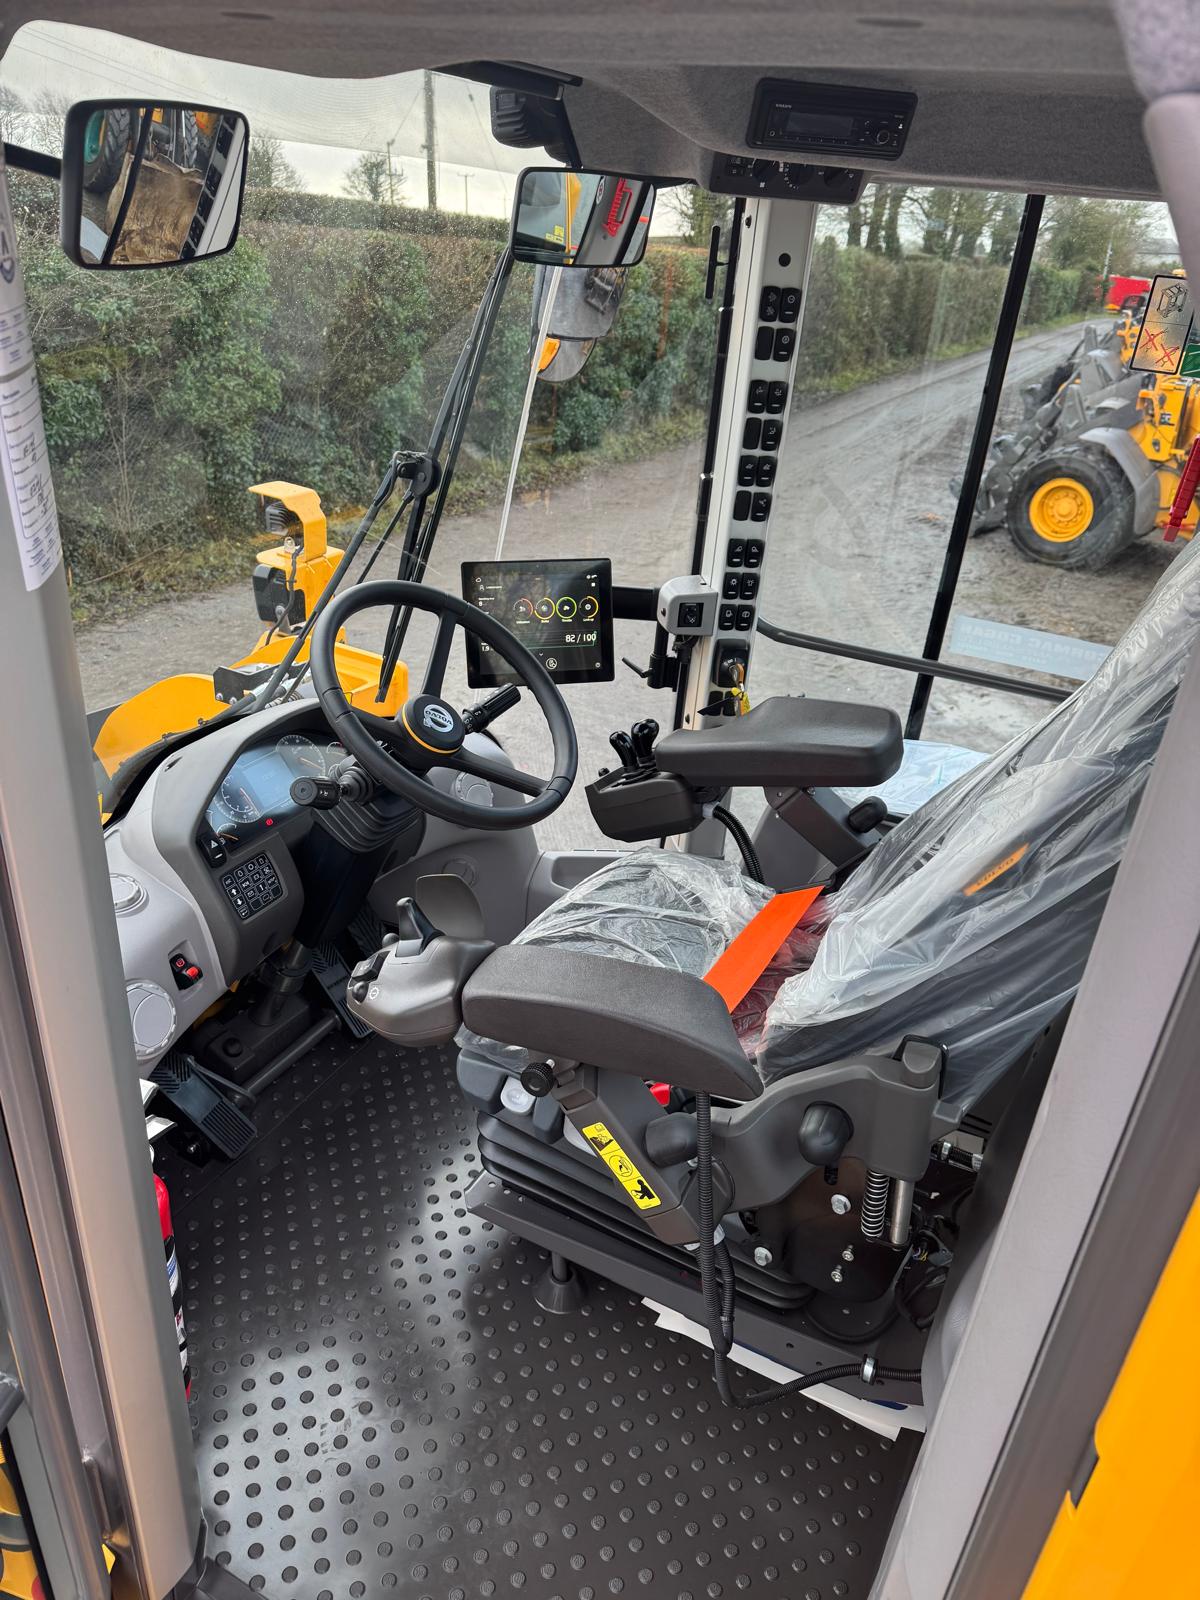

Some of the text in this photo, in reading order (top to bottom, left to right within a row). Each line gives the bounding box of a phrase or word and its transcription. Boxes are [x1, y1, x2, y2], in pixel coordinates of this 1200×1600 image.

[565, 634, 576, 643] 82
[583, 633, 597, 642] 100
[425, 710, 452, 725] VOLVO
